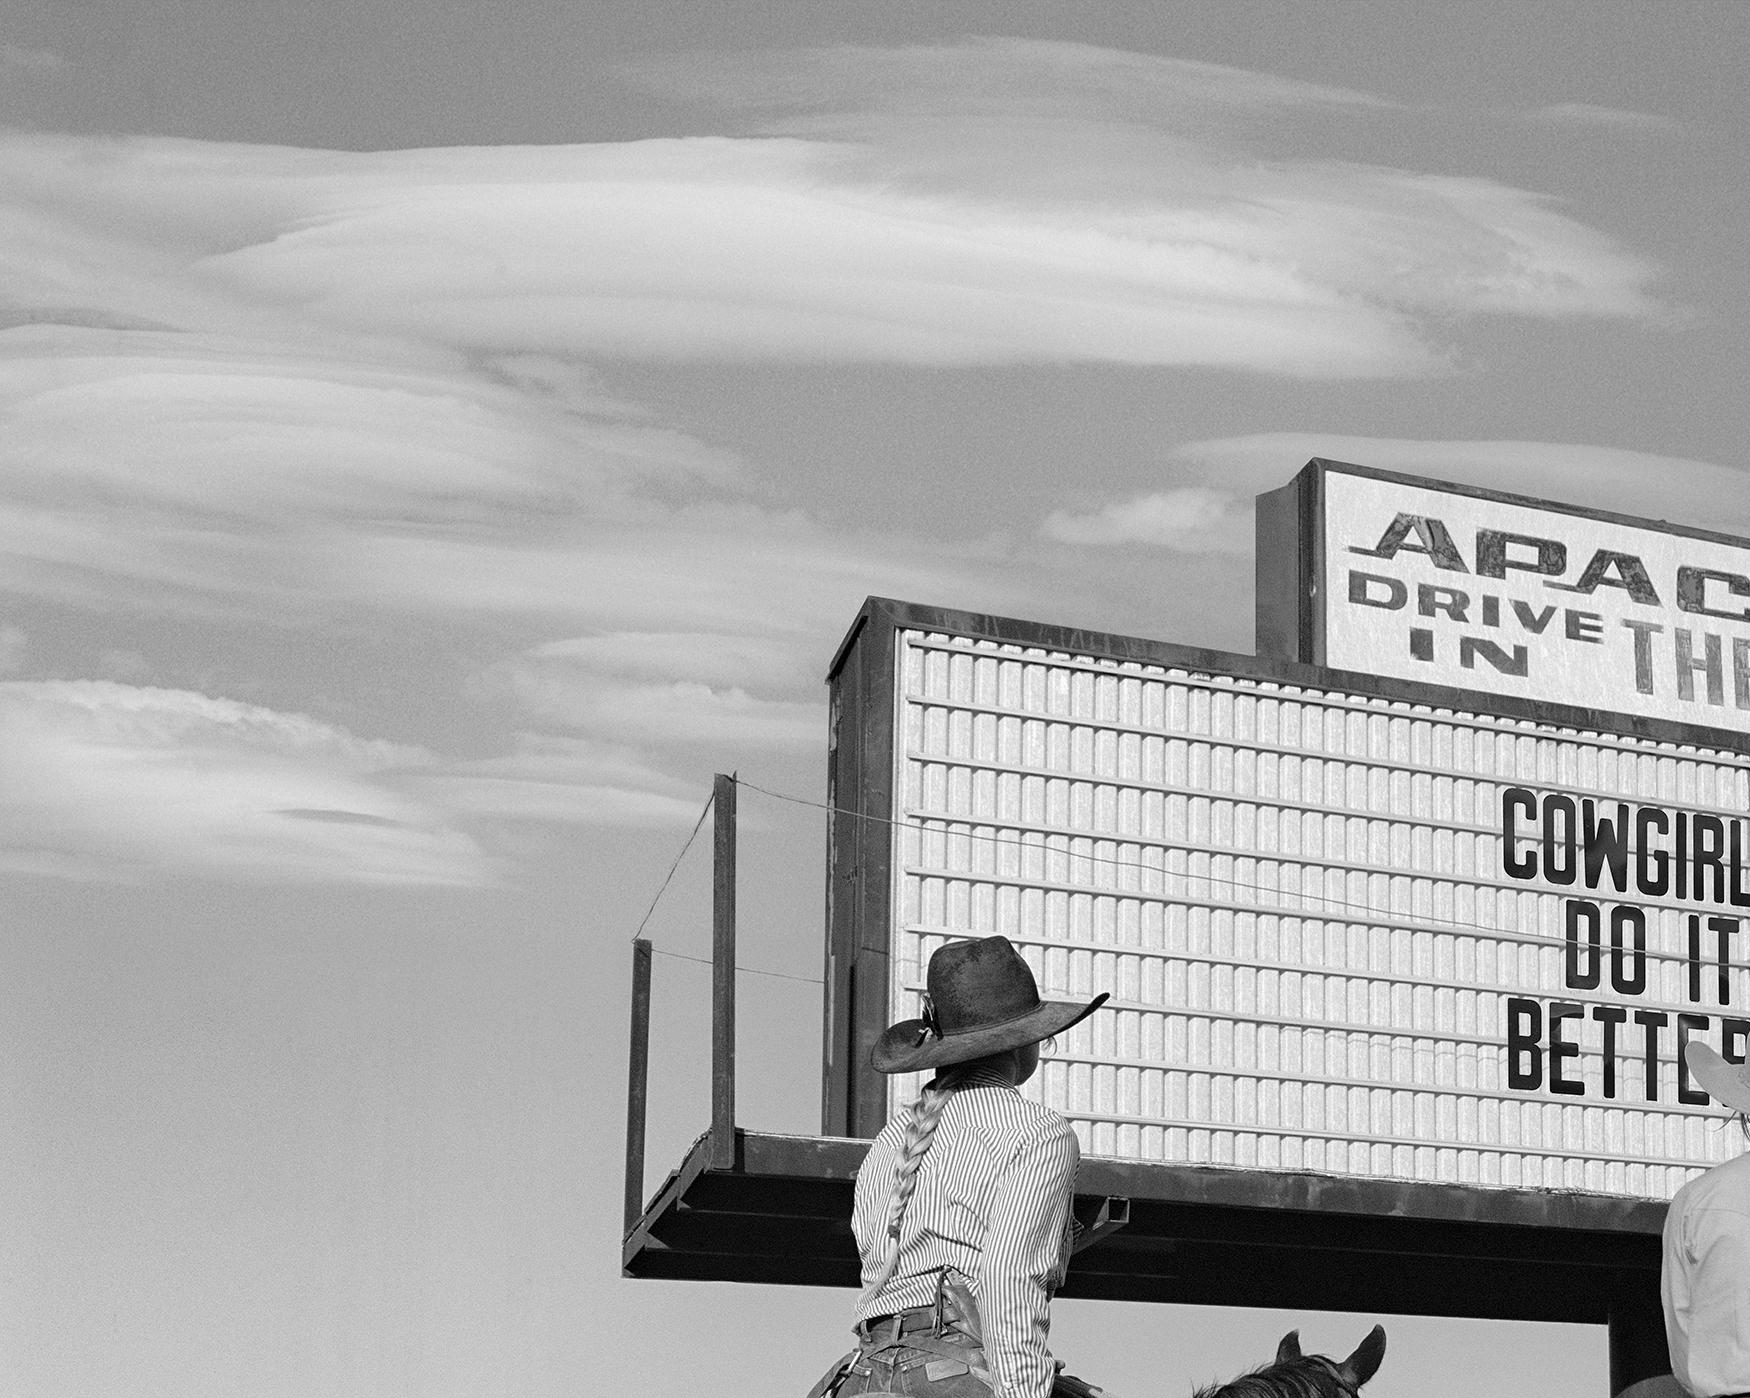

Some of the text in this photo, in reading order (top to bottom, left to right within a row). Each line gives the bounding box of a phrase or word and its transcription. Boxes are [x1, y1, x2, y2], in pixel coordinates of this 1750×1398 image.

[1348, 570, 1604, 643] DRIVE
[1410, 629, 1528, 677] IN
[1566, 900, 1739, 1005] DO IT
